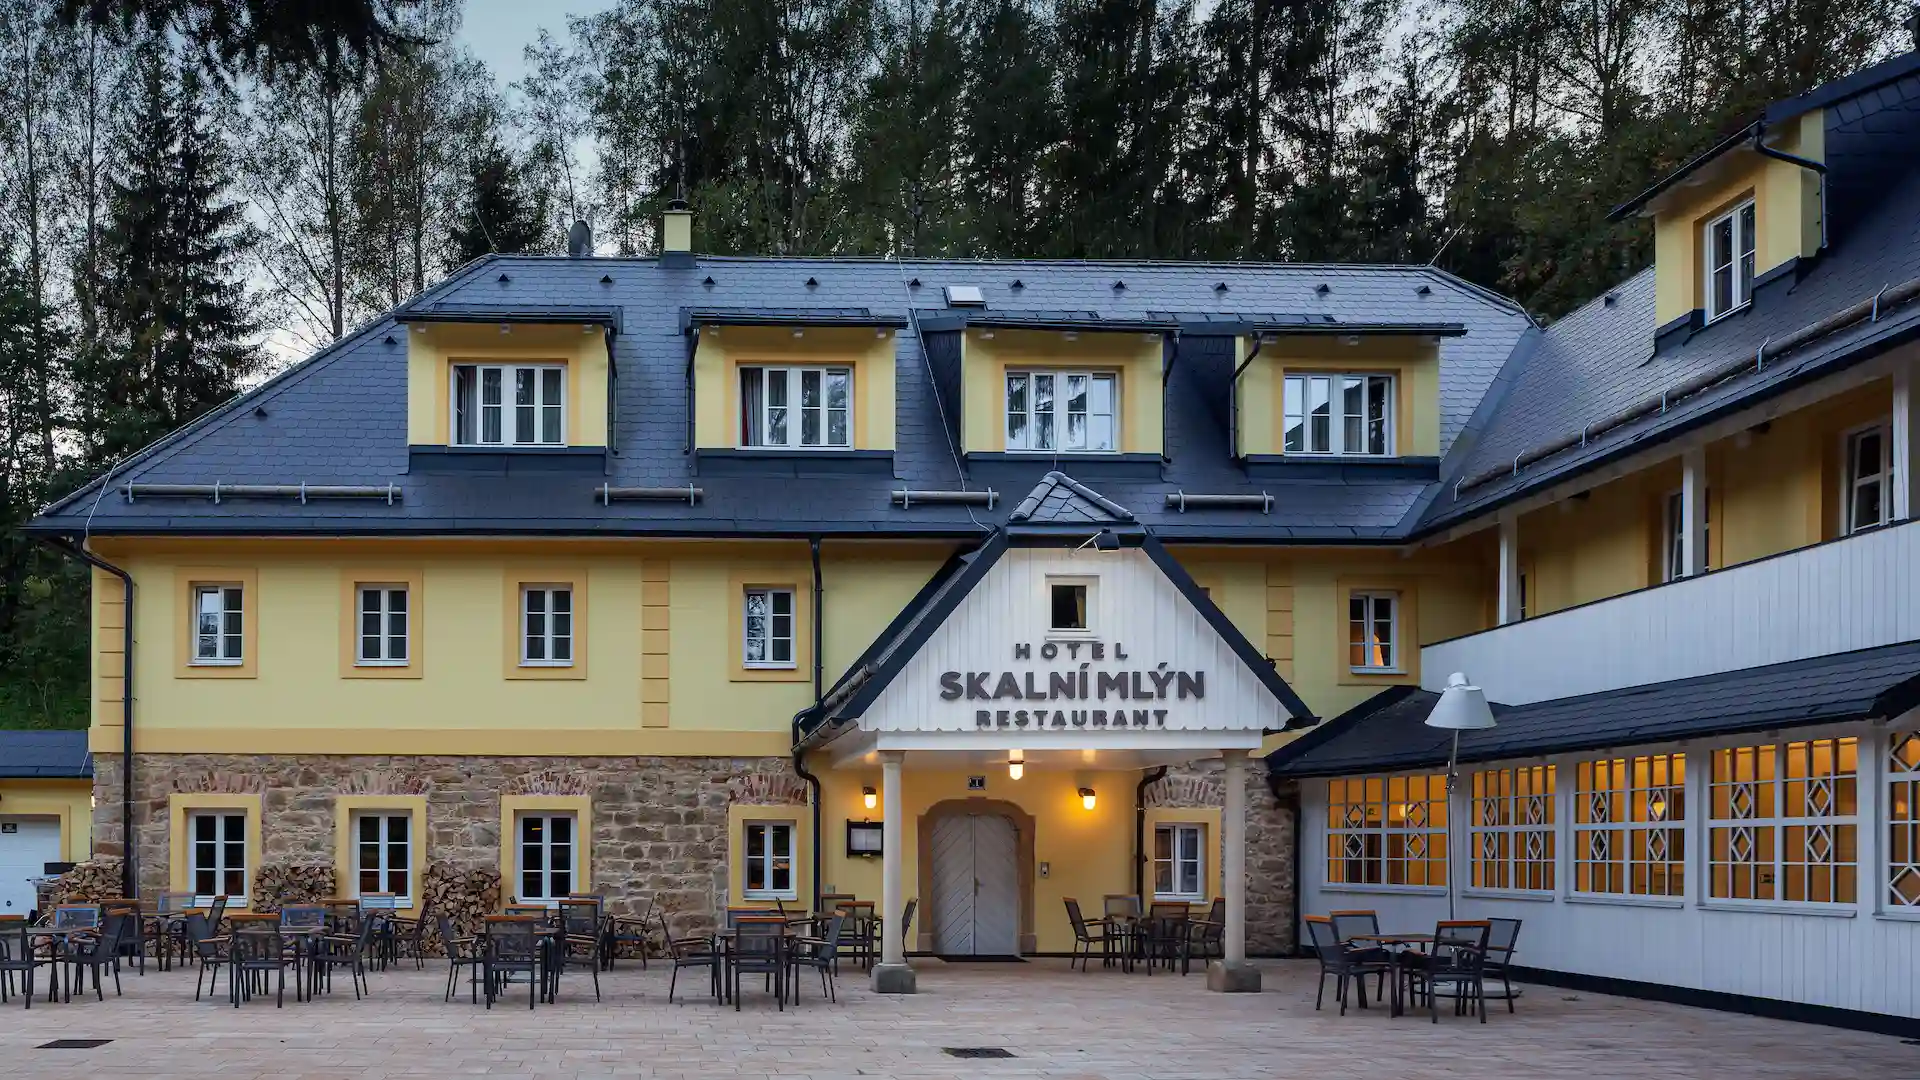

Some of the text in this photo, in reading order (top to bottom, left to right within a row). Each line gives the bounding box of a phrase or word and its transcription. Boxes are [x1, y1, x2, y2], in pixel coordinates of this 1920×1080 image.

[1015, 643, 1128, 660] HOTEL
[940, 662, 1205, 701] SKALNÍ MLÝN
[976, 709, 1168, 727] RESTAURANT
